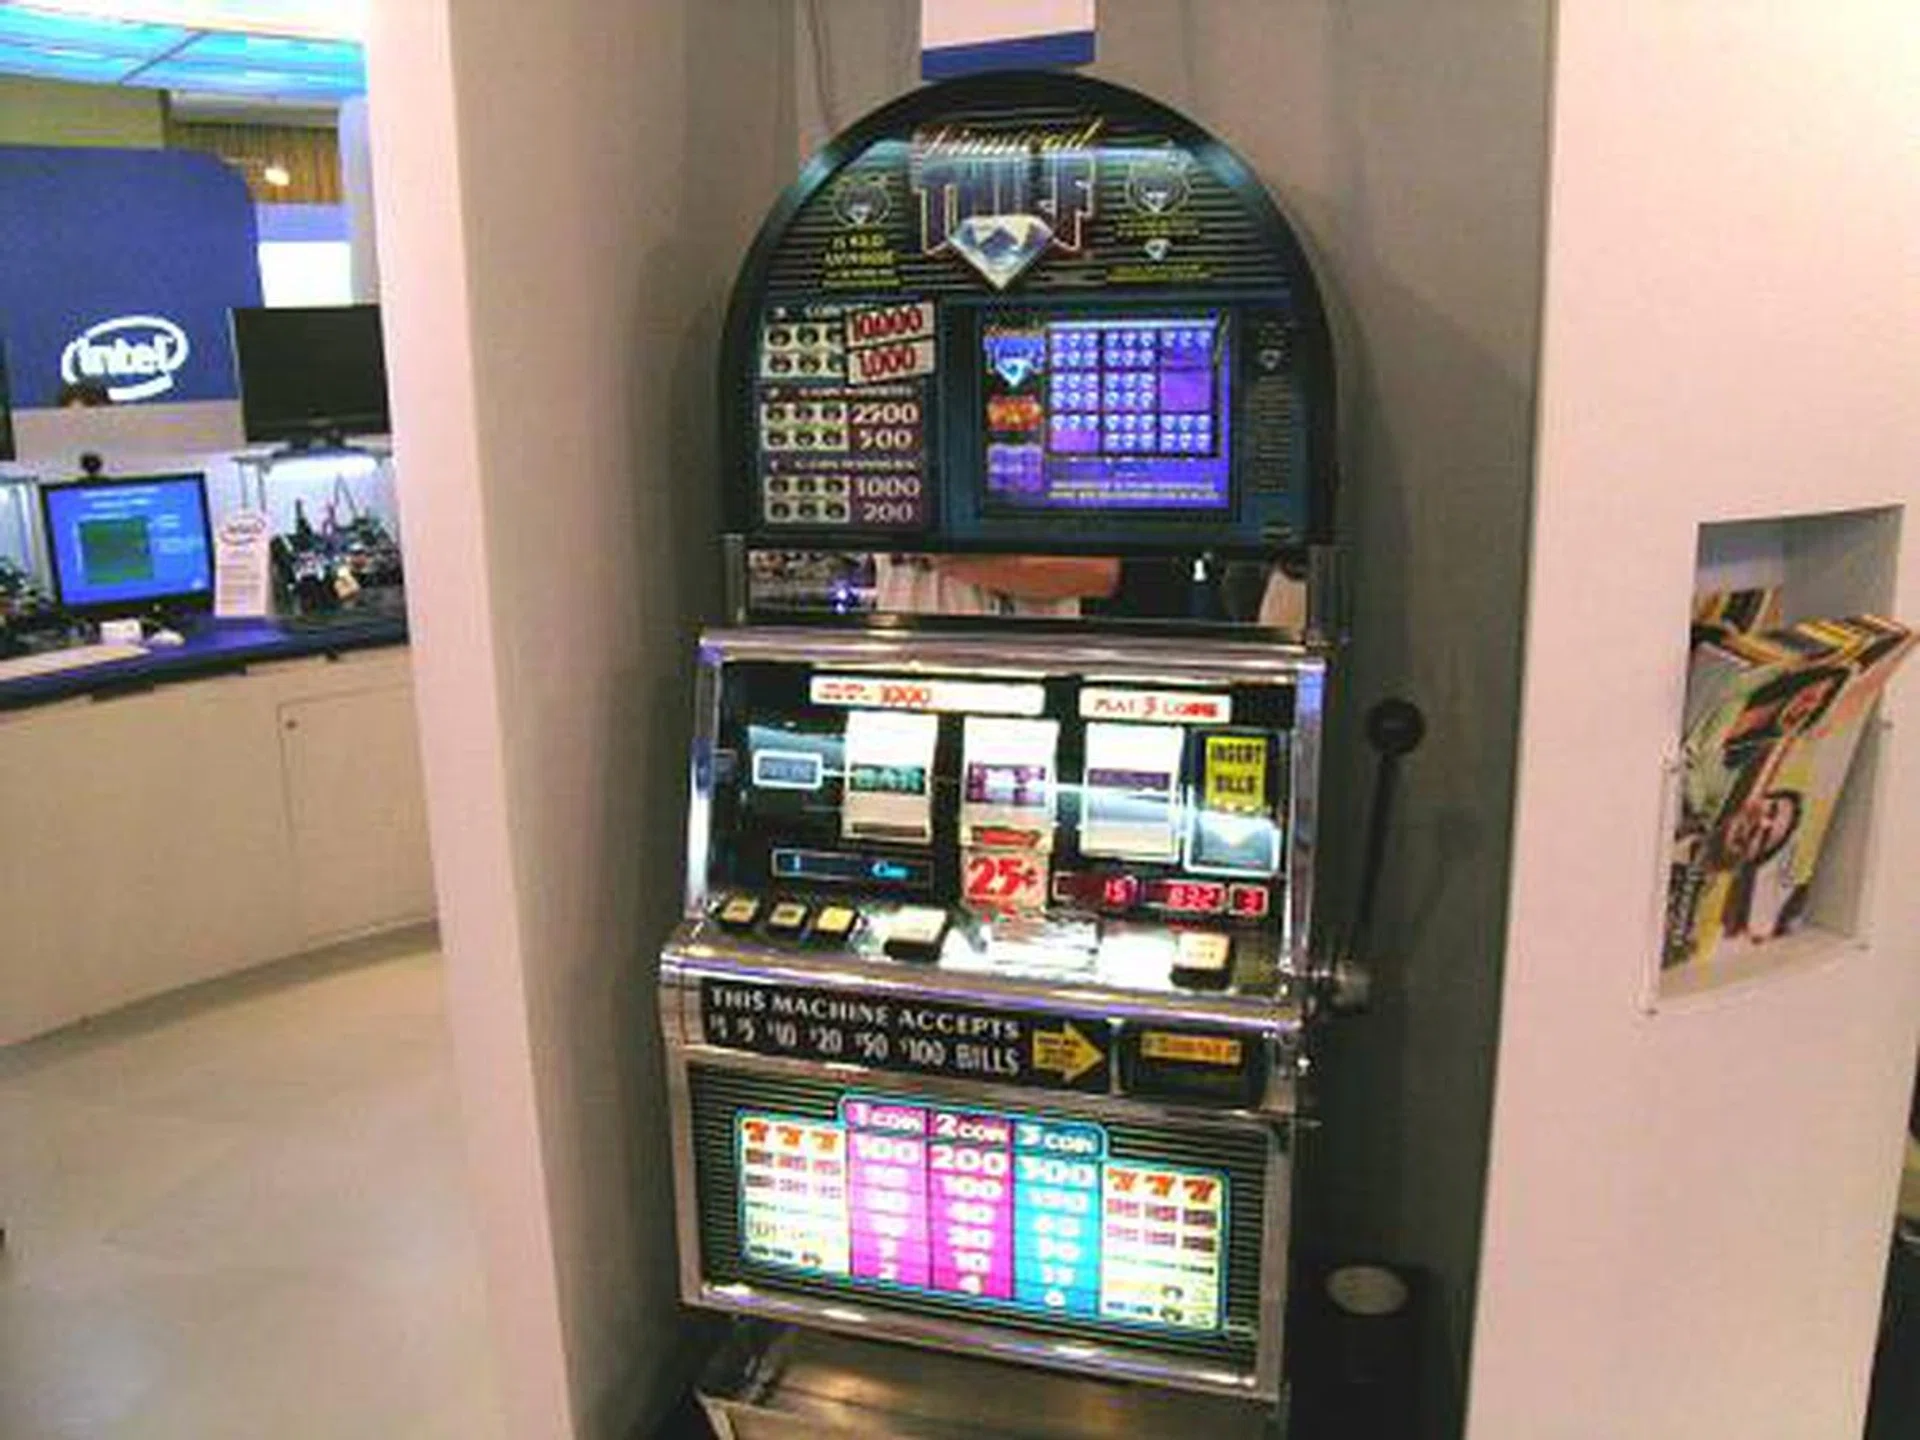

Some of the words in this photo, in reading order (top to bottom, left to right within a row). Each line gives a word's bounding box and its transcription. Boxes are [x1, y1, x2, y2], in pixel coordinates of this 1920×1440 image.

[857, 476, 921, 498] 1000
[969, 856, 1038, 896] 25¢
[711, 988, 766, 1012] THIS
[772, 995, 891, 1027] MACHINE
[900, 1009, 1019, 1040] ACCEPTS
[956, 1043, 1020, 1075] BILLS
[932, 1146, 1009, 1176] 200
